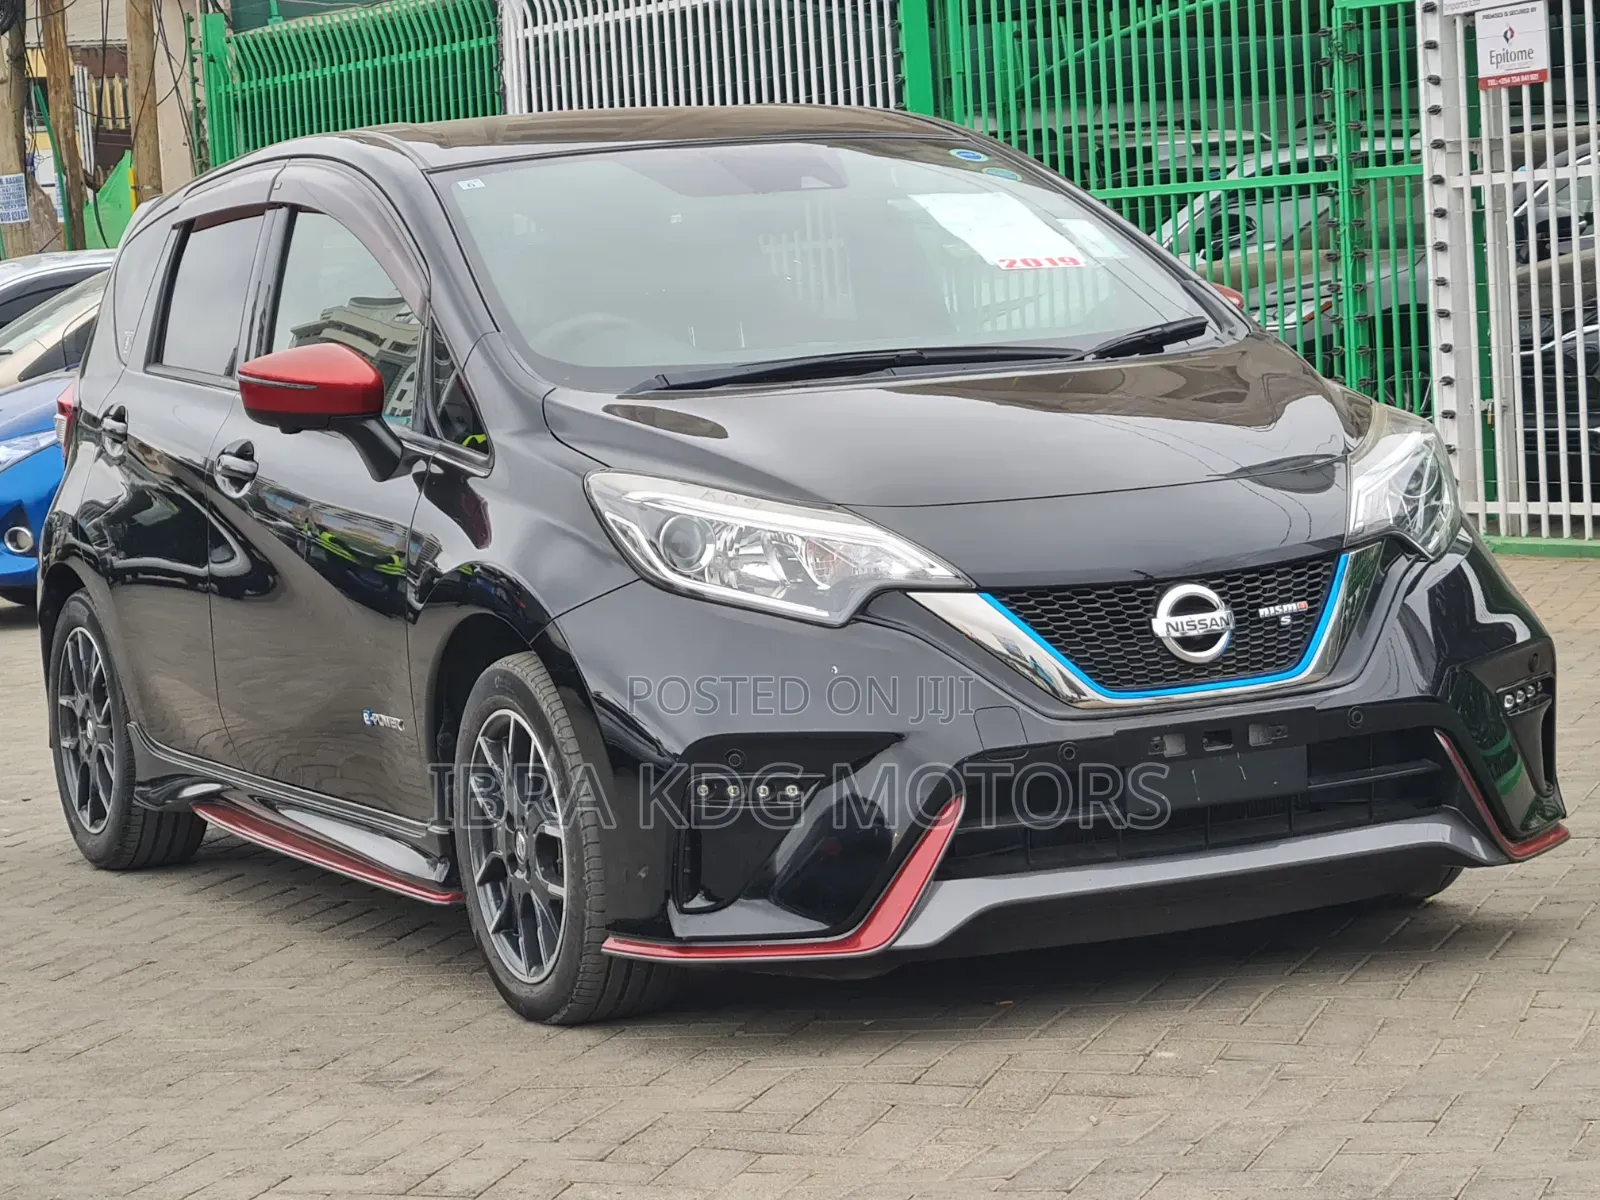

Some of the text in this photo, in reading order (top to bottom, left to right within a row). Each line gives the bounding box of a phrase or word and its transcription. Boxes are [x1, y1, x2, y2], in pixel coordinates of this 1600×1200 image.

[1489, 48, 1534, 69] Epitome
[998, 257, 1080, 268] 2019
[1165, 616, 1230, 633] NISSAN
[1280, 615, 1292, 626] S
